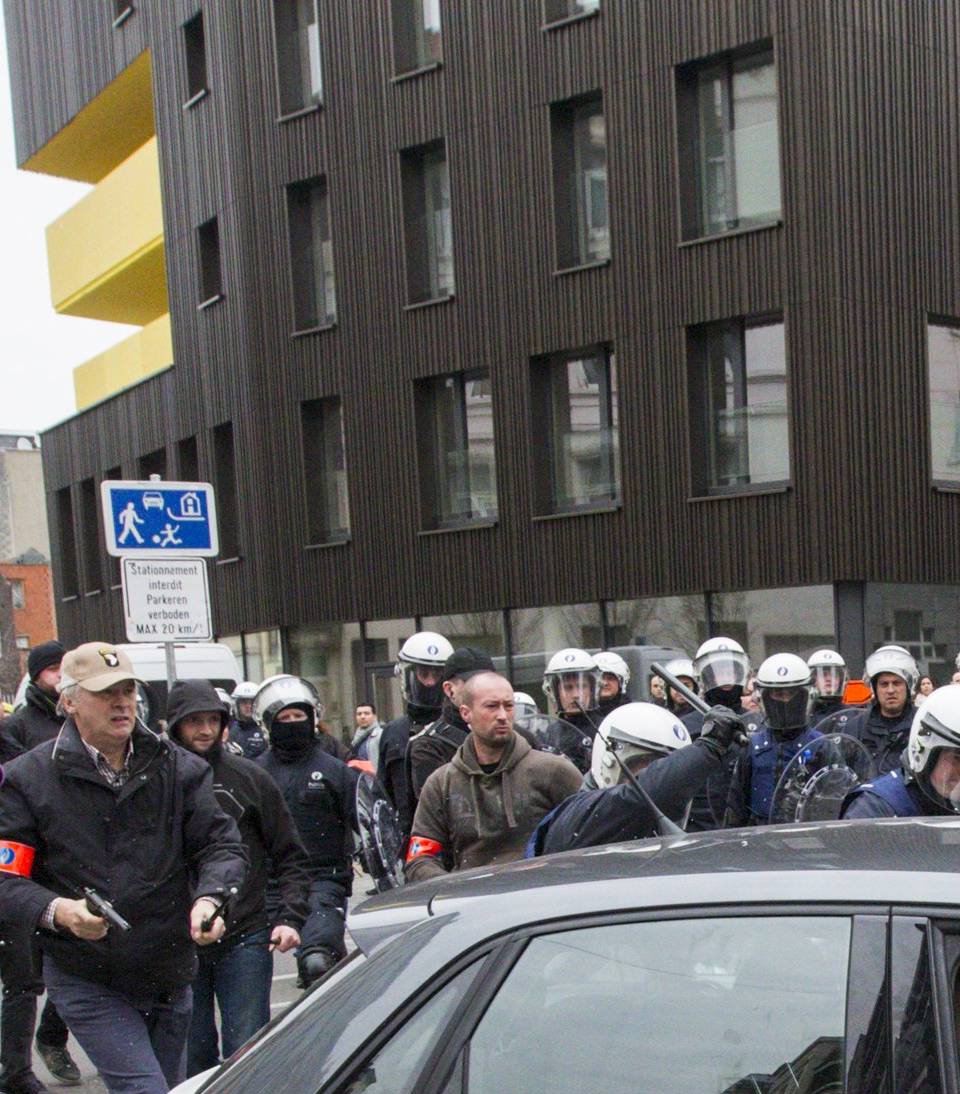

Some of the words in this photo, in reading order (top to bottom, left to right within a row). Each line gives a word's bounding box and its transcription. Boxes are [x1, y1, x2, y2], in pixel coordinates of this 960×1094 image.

[131, 564, 198, 575] Stationnement
[148, 580, 182, 590] interdit
[146, 594, 188, 605] Parkeren
[147, 610, 190, 620] verboden
[136, 624, 158, 634] MAX
[162, 623, 175, 634] 20
